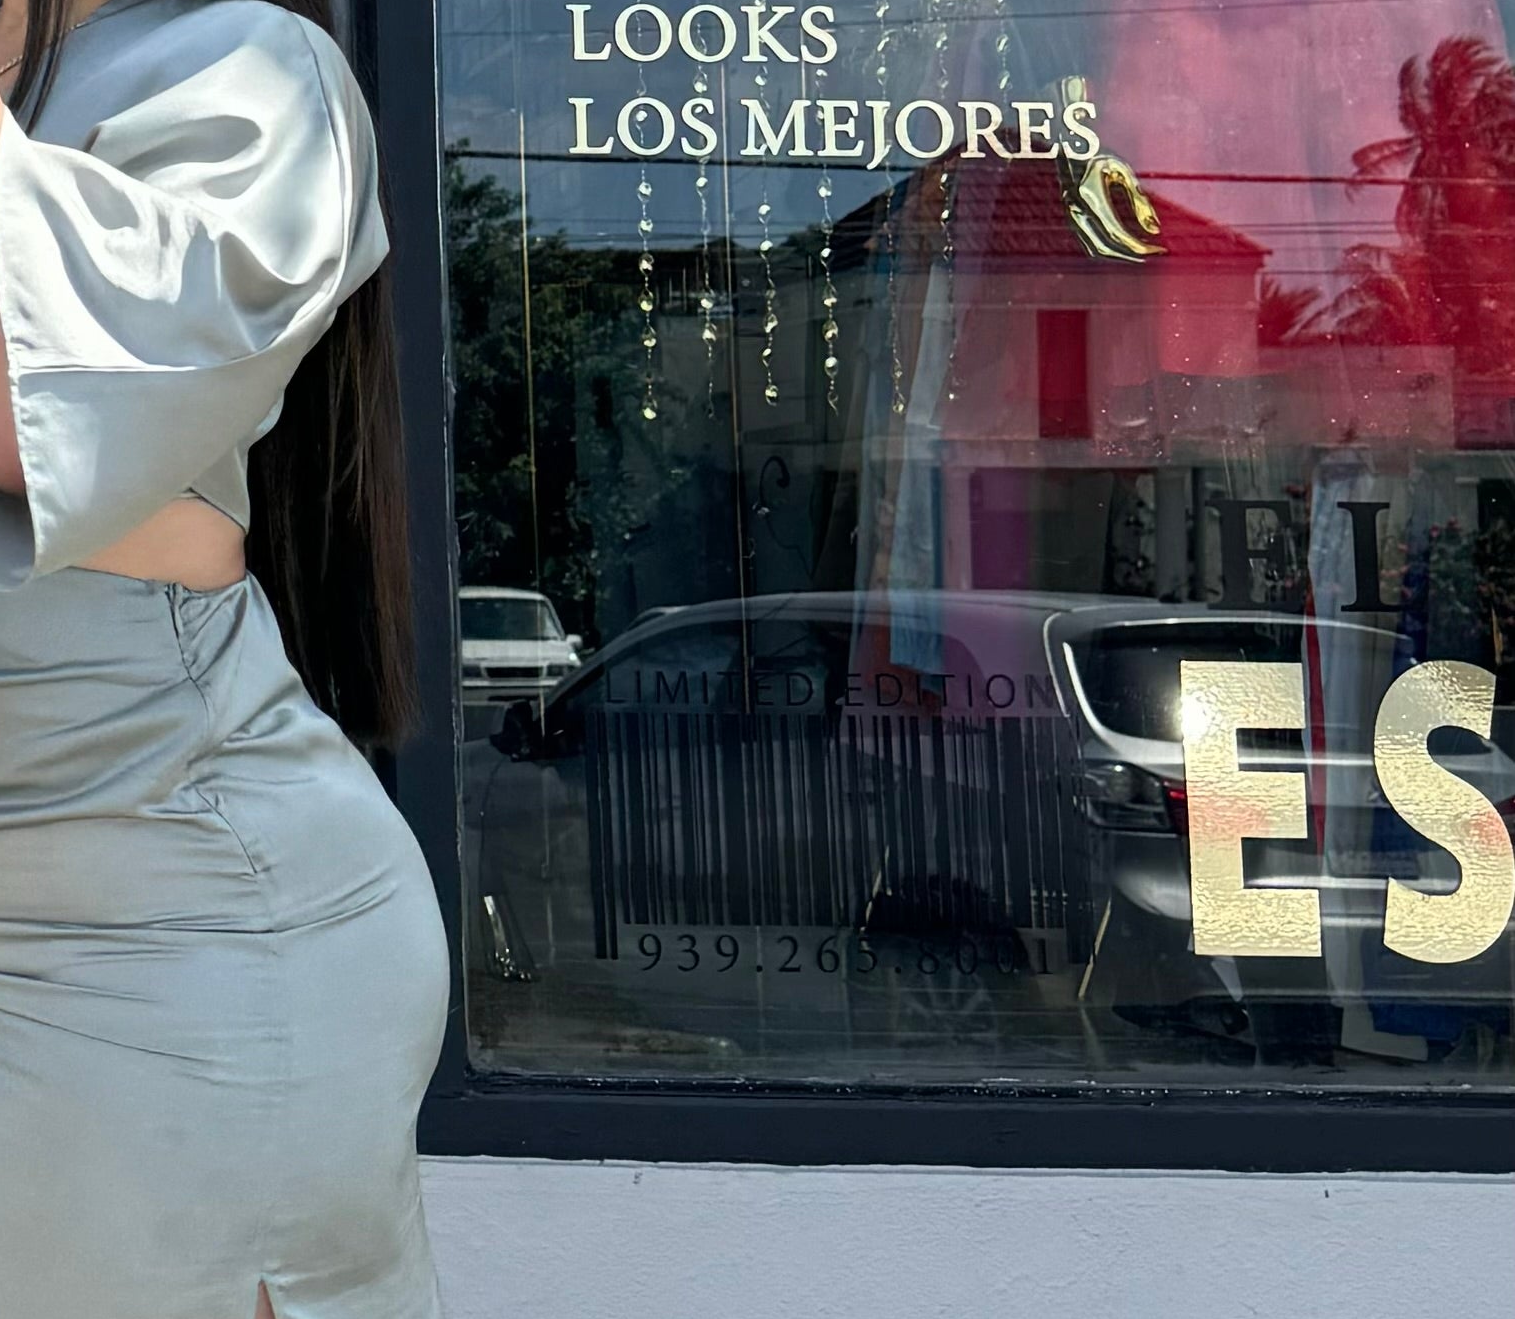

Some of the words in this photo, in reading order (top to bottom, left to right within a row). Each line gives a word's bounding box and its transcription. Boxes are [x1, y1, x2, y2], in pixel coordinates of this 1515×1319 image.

[566, 3, 838, 64] LOOKS
[568, 97, 718, 156] LOS
[740, 98, 1101, 171] MEJORES
[605, 670, 815, 707] LIMITED
[844, 672, 1056, 709] EDITION
[1180, 659, 1515, 964] ES
[637, 933, 1055, 976] 939.265.8001
